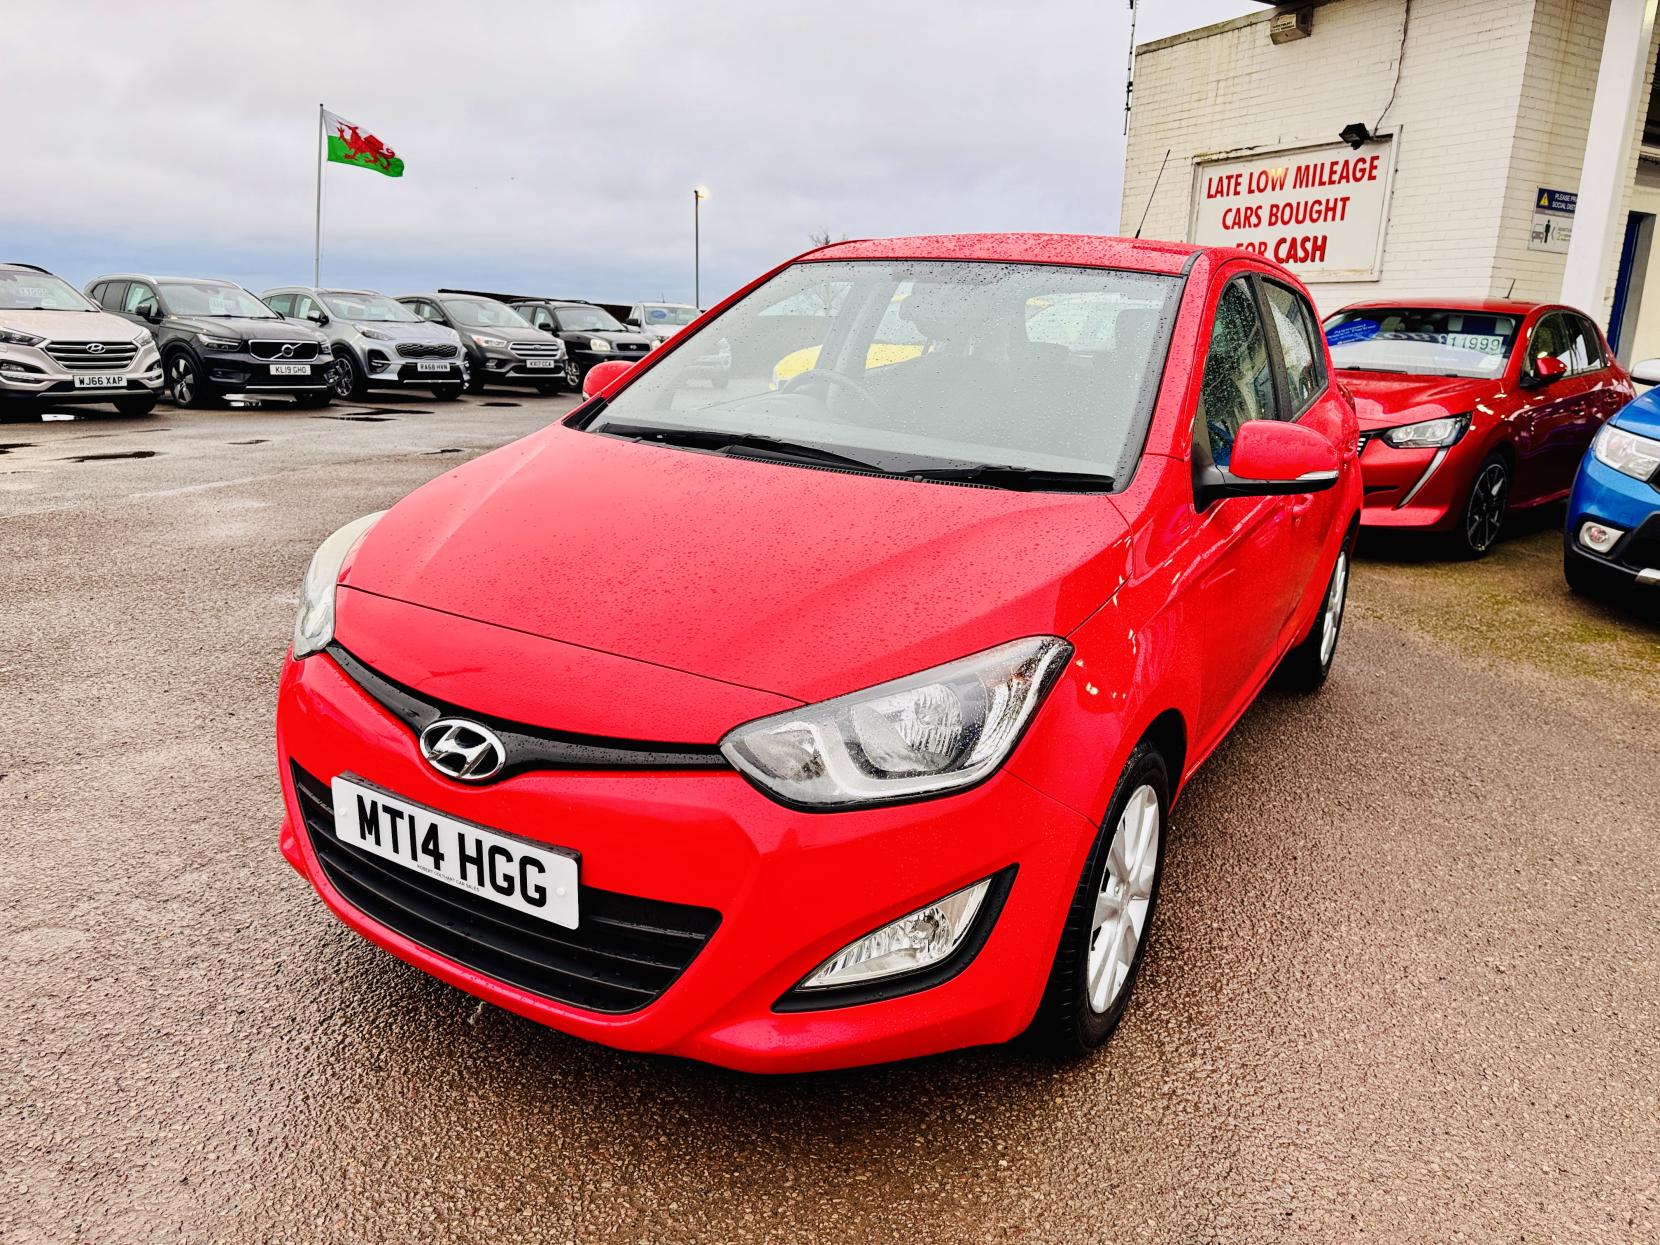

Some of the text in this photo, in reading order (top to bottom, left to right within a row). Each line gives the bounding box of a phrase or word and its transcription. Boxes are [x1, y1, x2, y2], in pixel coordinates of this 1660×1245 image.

[1206, 155, 1380, 199] LATE LOW MILEAGE
[1554, 193, 1570, 202] PLEASE
[1552, 201, 1566, 210] SOCIAL
[1222, 196, 1350, 231] CARS BOUGHT
[1273, 235, 1328, 264] CASH
[1450, 336, 1500, 352] 11999
[275, 366, 292, 374] KL19
[78, 376, 123, 386] WJ66 XAP
[356, 794, 548, 909] MT14 HGG
[465, 883, 480, 892] SALES
